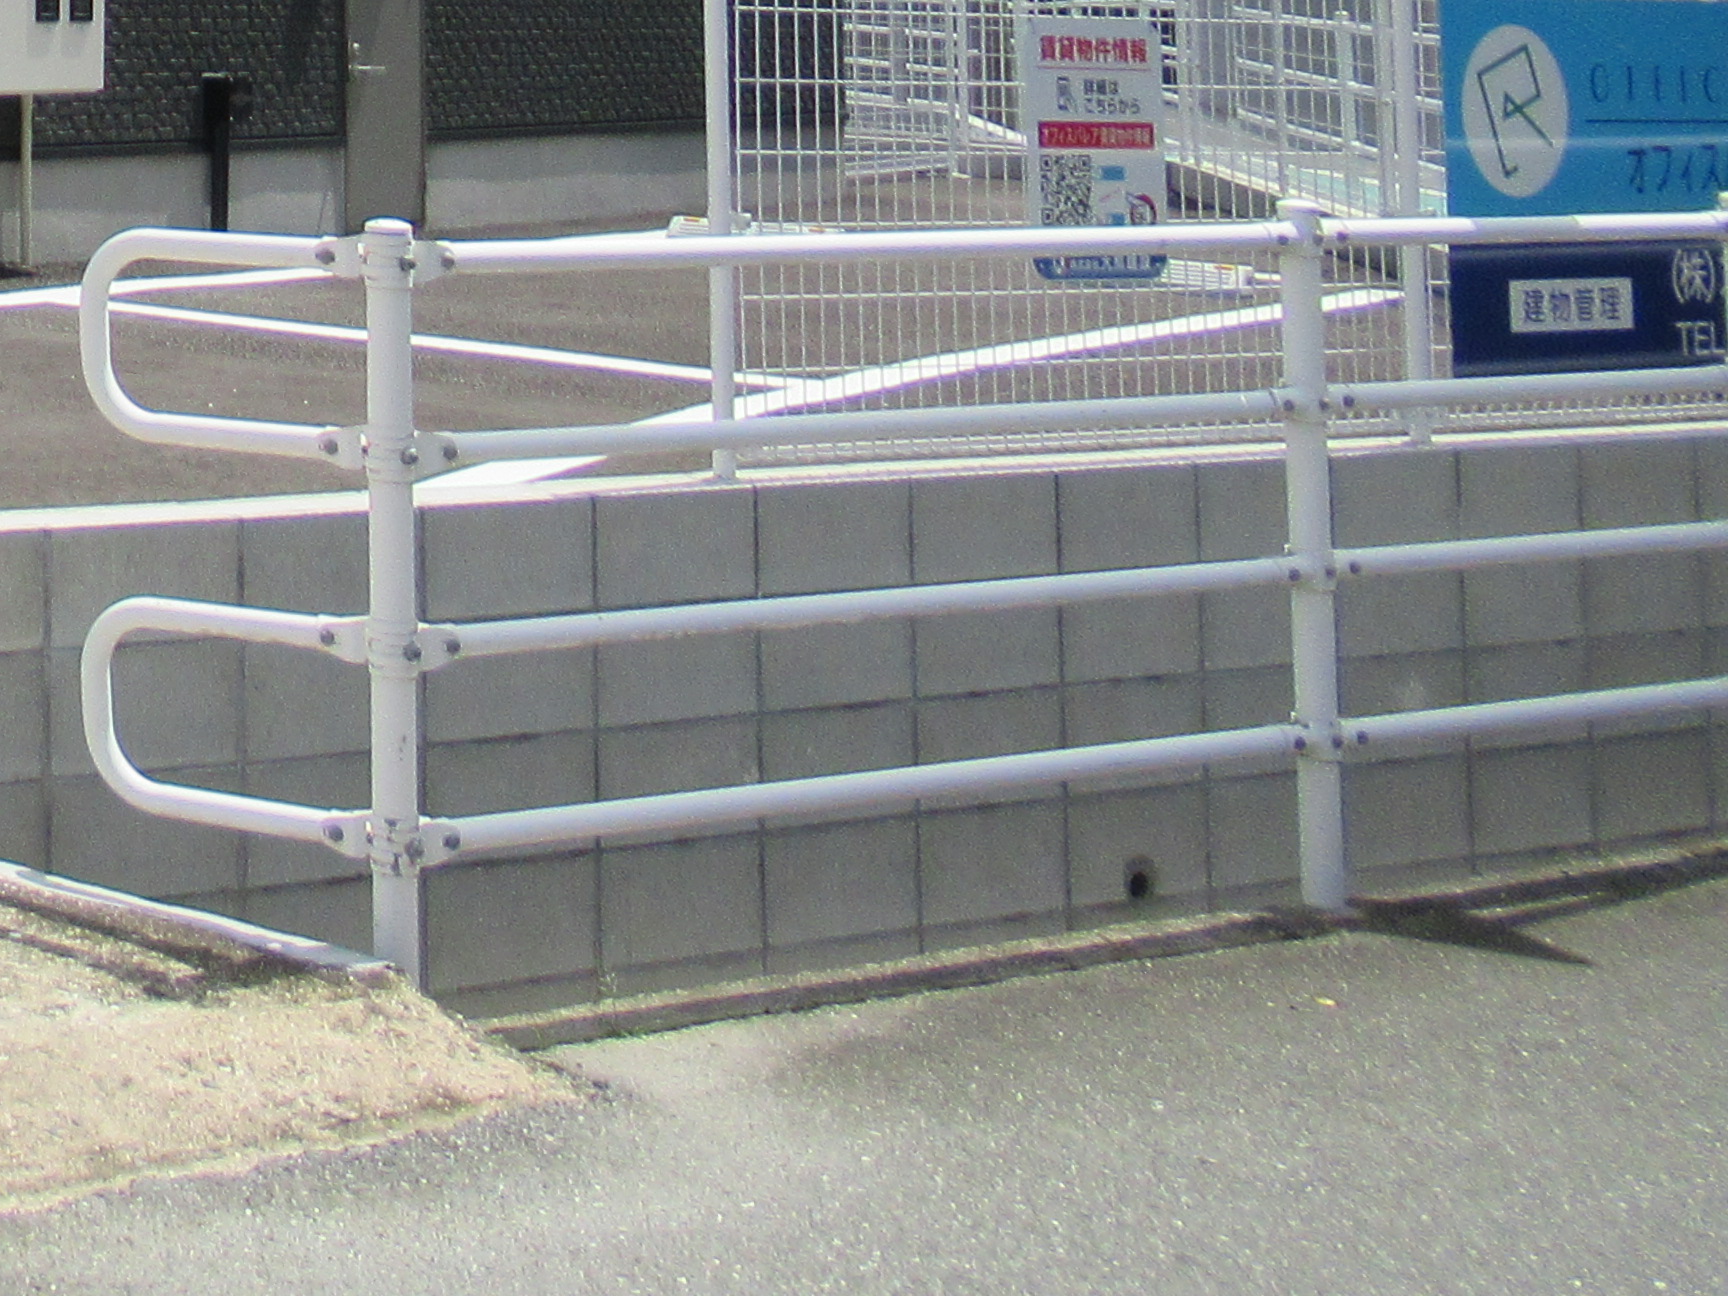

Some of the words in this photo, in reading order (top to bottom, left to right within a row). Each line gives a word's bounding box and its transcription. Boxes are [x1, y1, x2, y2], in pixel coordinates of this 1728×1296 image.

[1084, 98, 1141, 114] こちらから
[1522, 286, 1621, 323] 建物管理
[1675, 321, 1725, 356] TEL
